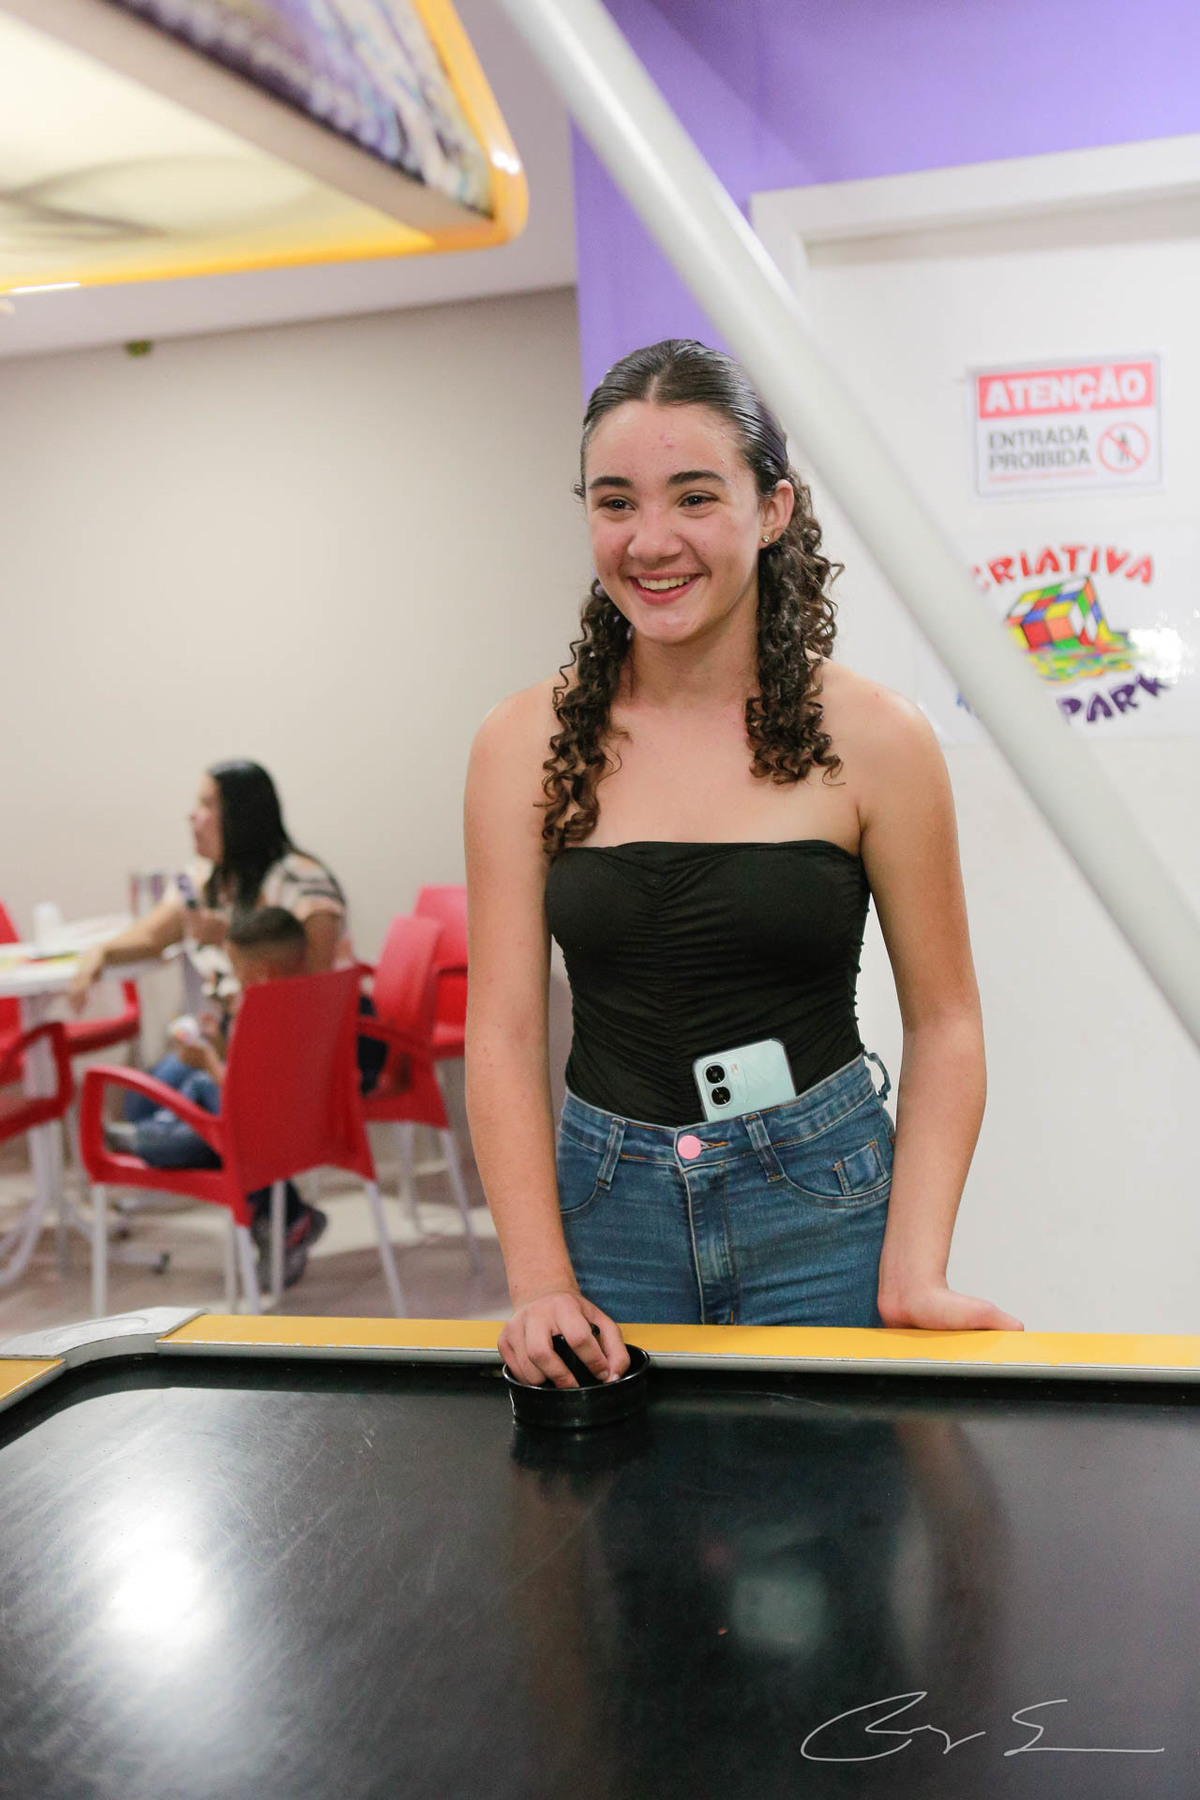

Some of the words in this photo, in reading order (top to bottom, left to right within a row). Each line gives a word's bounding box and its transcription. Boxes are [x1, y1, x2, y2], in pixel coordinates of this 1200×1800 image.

[984, 367, 1147, 413] ATENÇÃO
[988, 425, 1089, 450] ENTRADA
[988, 447, 1091, 472] PROIBIDA
[1057, 673, 1169, 726] PARK
